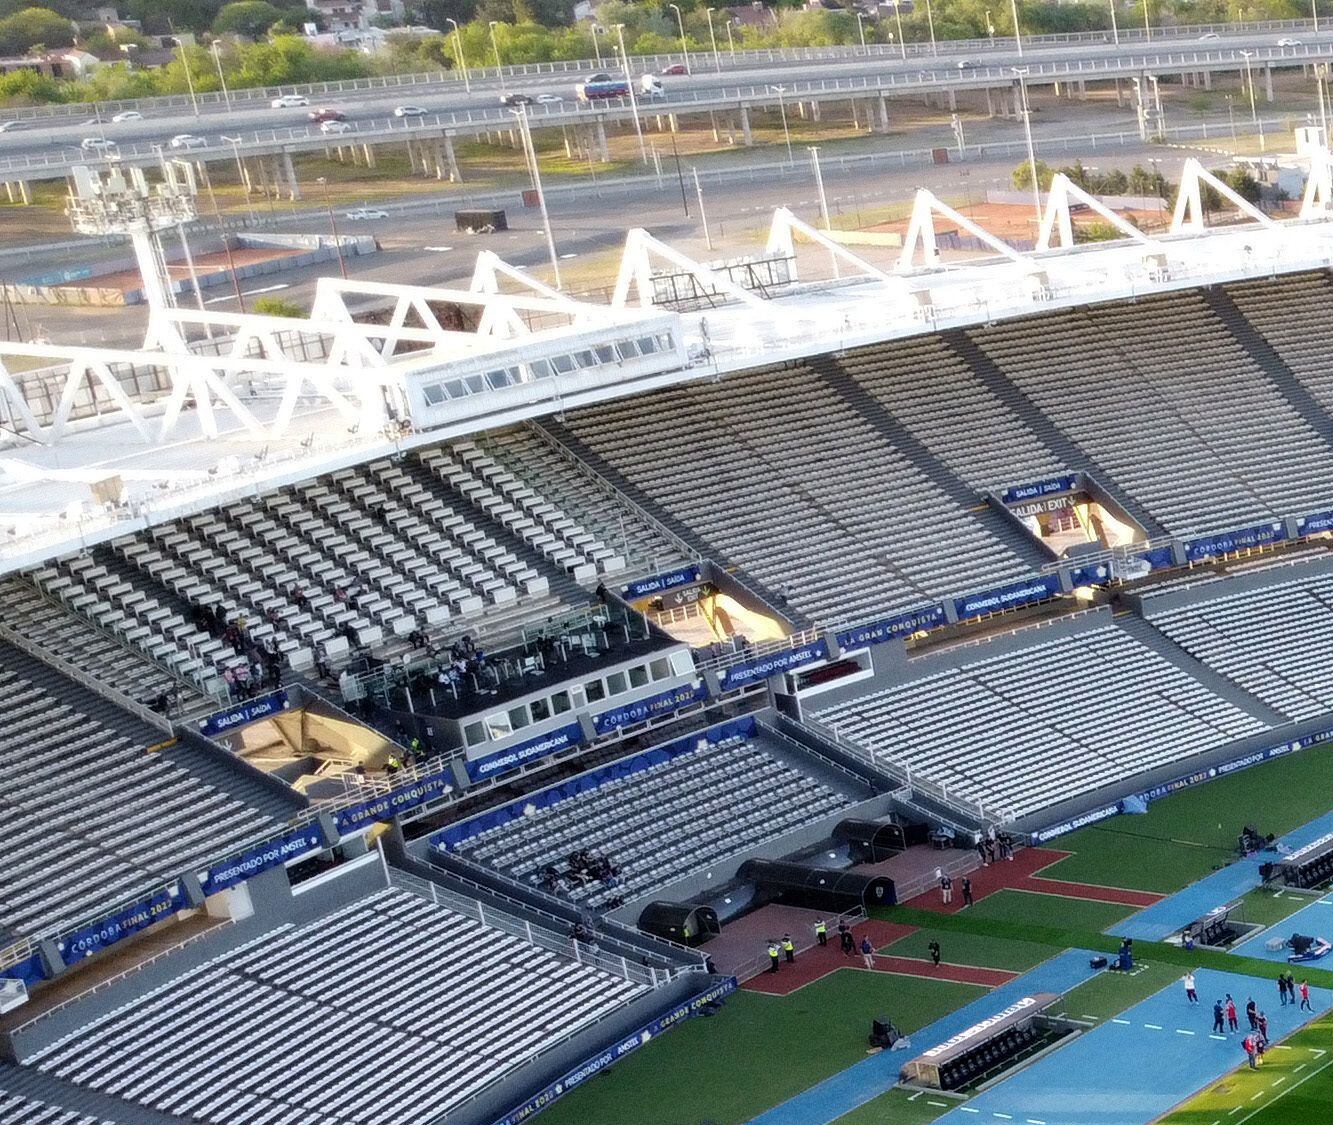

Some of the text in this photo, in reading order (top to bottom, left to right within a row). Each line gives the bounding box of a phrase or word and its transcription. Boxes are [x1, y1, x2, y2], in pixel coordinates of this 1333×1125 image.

[1016, 487, 1039, 498] SALIDA
[1048, 497, 1067, 511] EXIT
[637, 581, 660, 594] SALIDA
[859, 630, 883, 643] GRAN
[886, 613, 937, 635] CONQUISTA
[730, 662, 773, 682] PRESENTADO
[773, 658, 788, 669] POR
[217, 712, 245, 728] SALIDA
[351, 801, 389, 825] GRANDE
[391, 779, 444, 806] CONQUISTA
[214, 857, 262, 884] PRESENTADO
[262, 850, 279, 864] POR
[71, 923, 123, 955] CÓRDOBA
[122, 912, 149, 930] FINAL
[660, 982, 733, 1028] GRANDE CONQUISTA
[565, 1059, 600, 1087] PRESENTADO
[600, 1053, 612, 1066] POR
